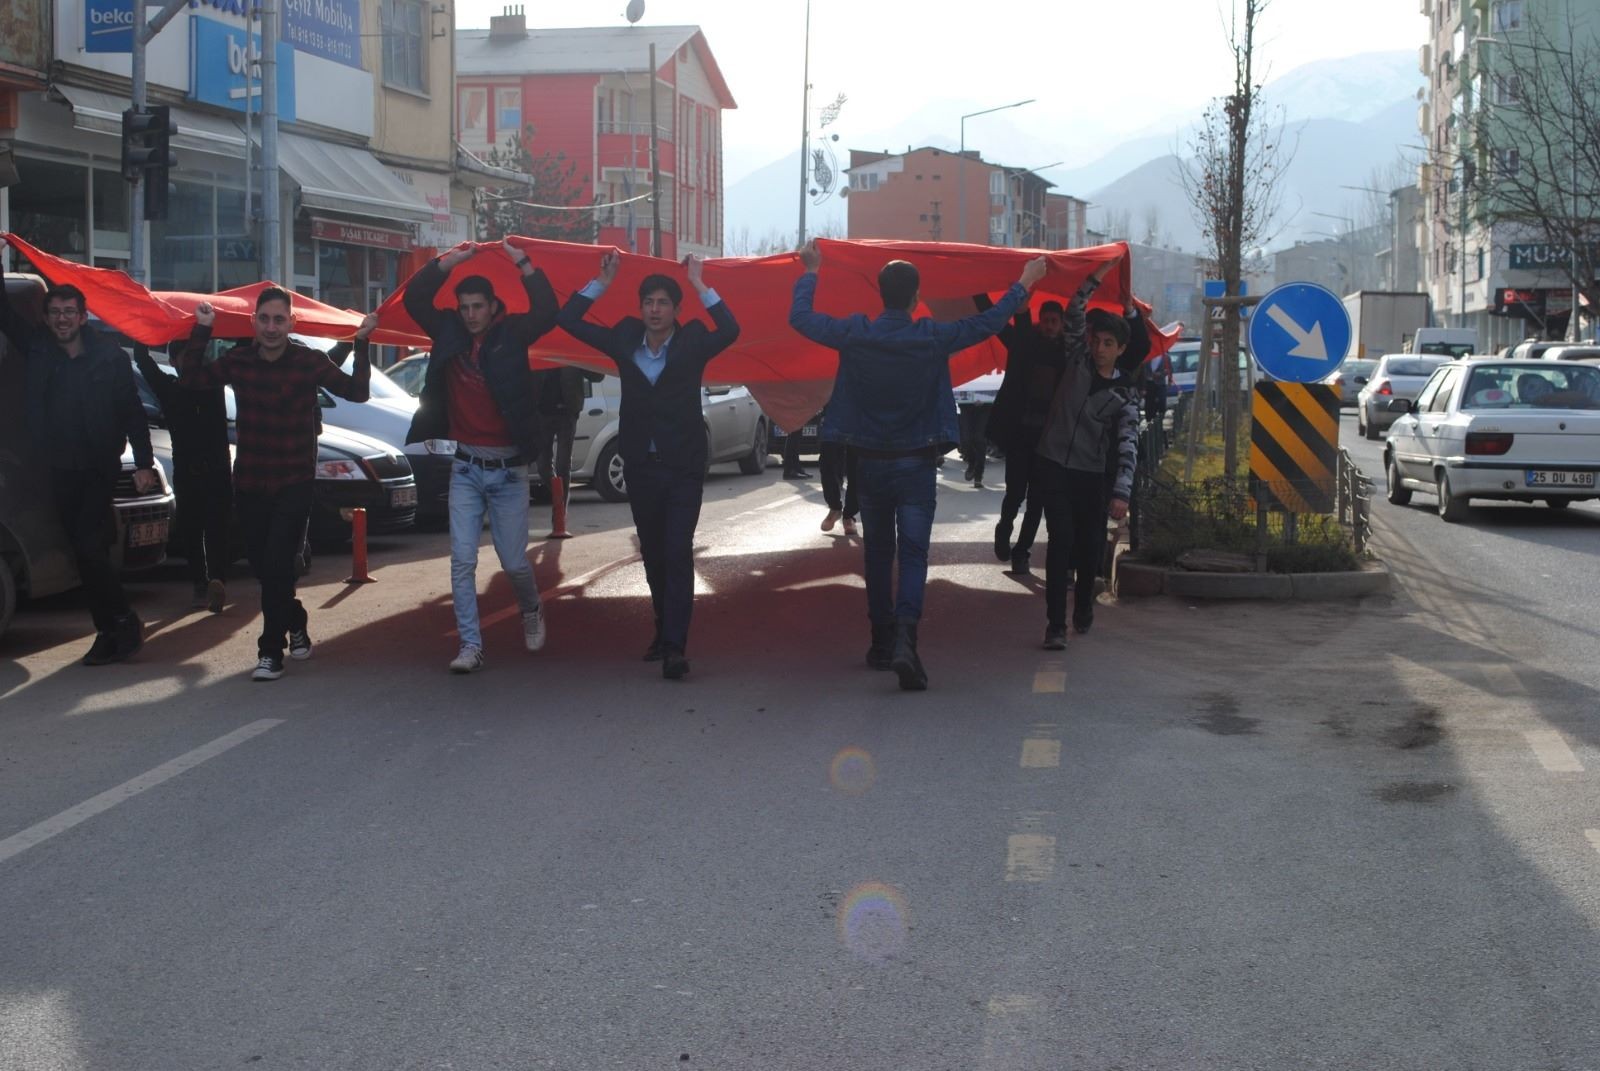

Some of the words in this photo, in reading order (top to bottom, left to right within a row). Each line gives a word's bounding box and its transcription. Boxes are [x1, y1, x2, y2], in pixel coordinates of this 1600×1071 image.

[90, 8, 134, 24] beko
[1534, 472, 1546, 482] 25
[1552, 472, 1566, 483] DU
